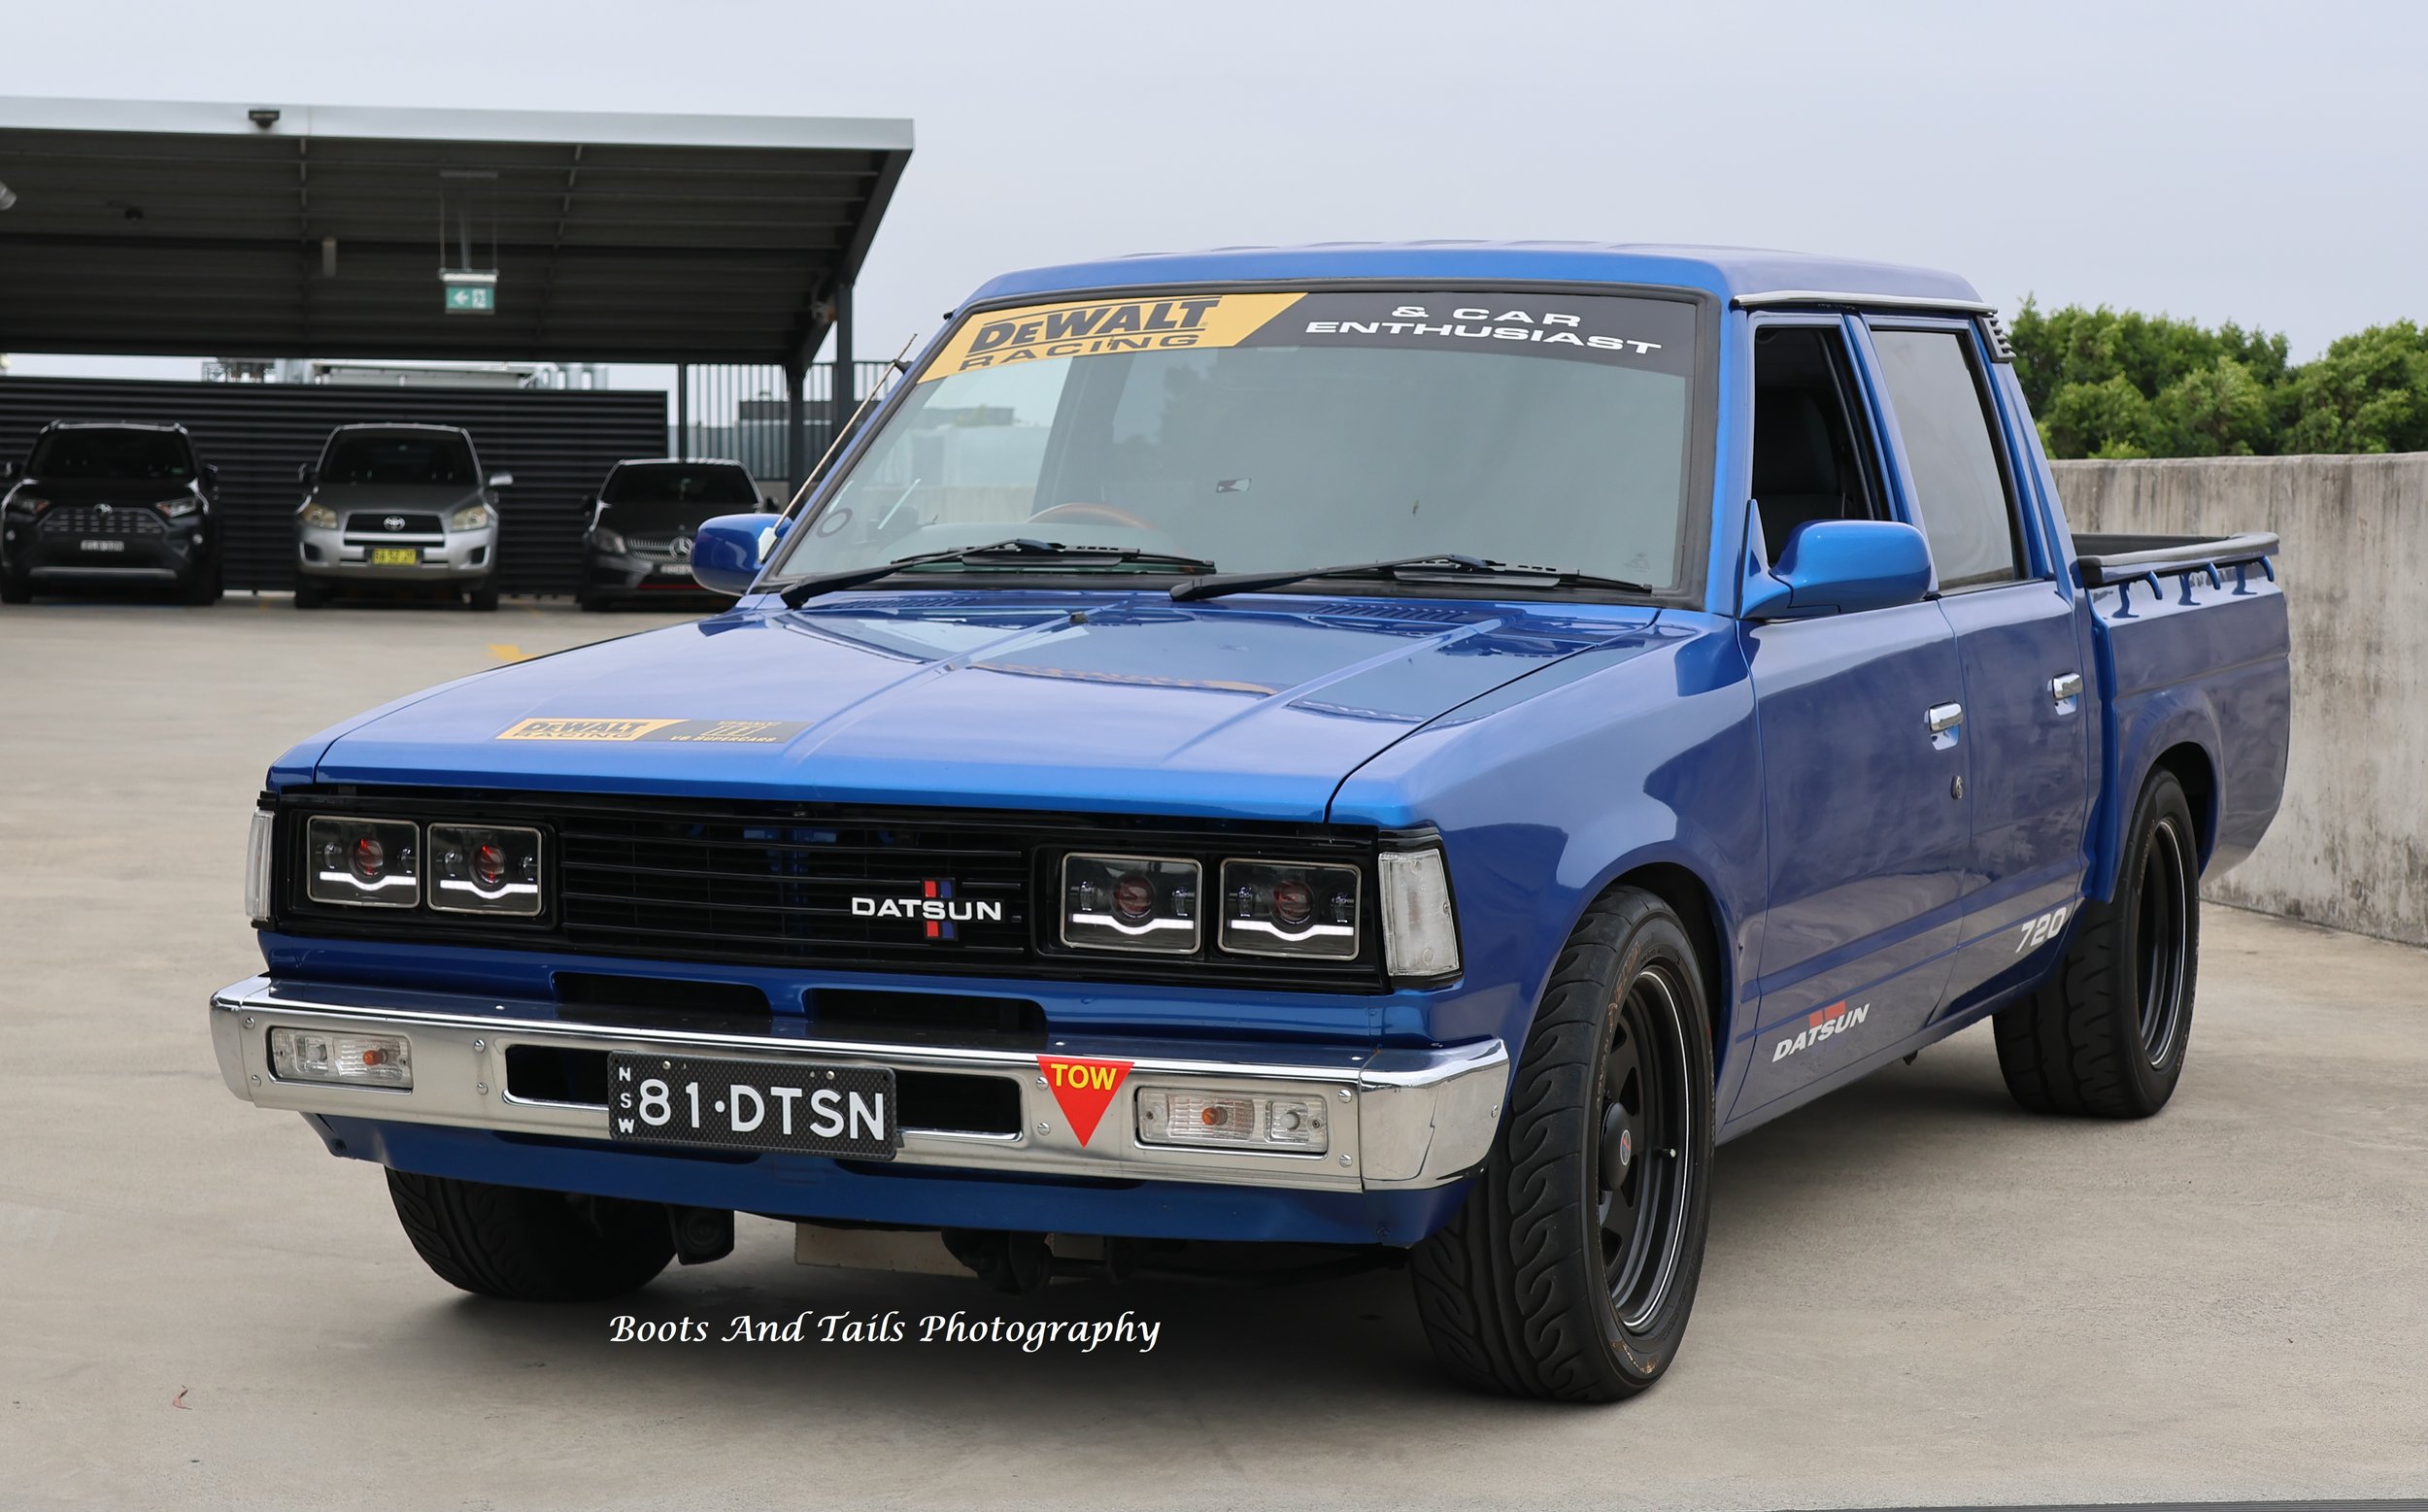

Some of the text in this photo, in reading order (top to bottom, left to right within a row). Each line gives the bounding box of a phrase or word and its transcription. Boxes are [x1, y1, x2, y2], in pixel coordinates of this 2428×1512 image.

[1392, 306, 1581, 327] & CAR
[958, 334, 1199, 371] RACING
[1305, 321, 1662, 355] ENTHUSIAST
[852, 897, 1001, 921] DATSUN
[2015, 907, 2067, 954] 720
[1771, 1003, 1871, 1062] DATSUN
[1050, 1063, 1117, 1091] TOW
